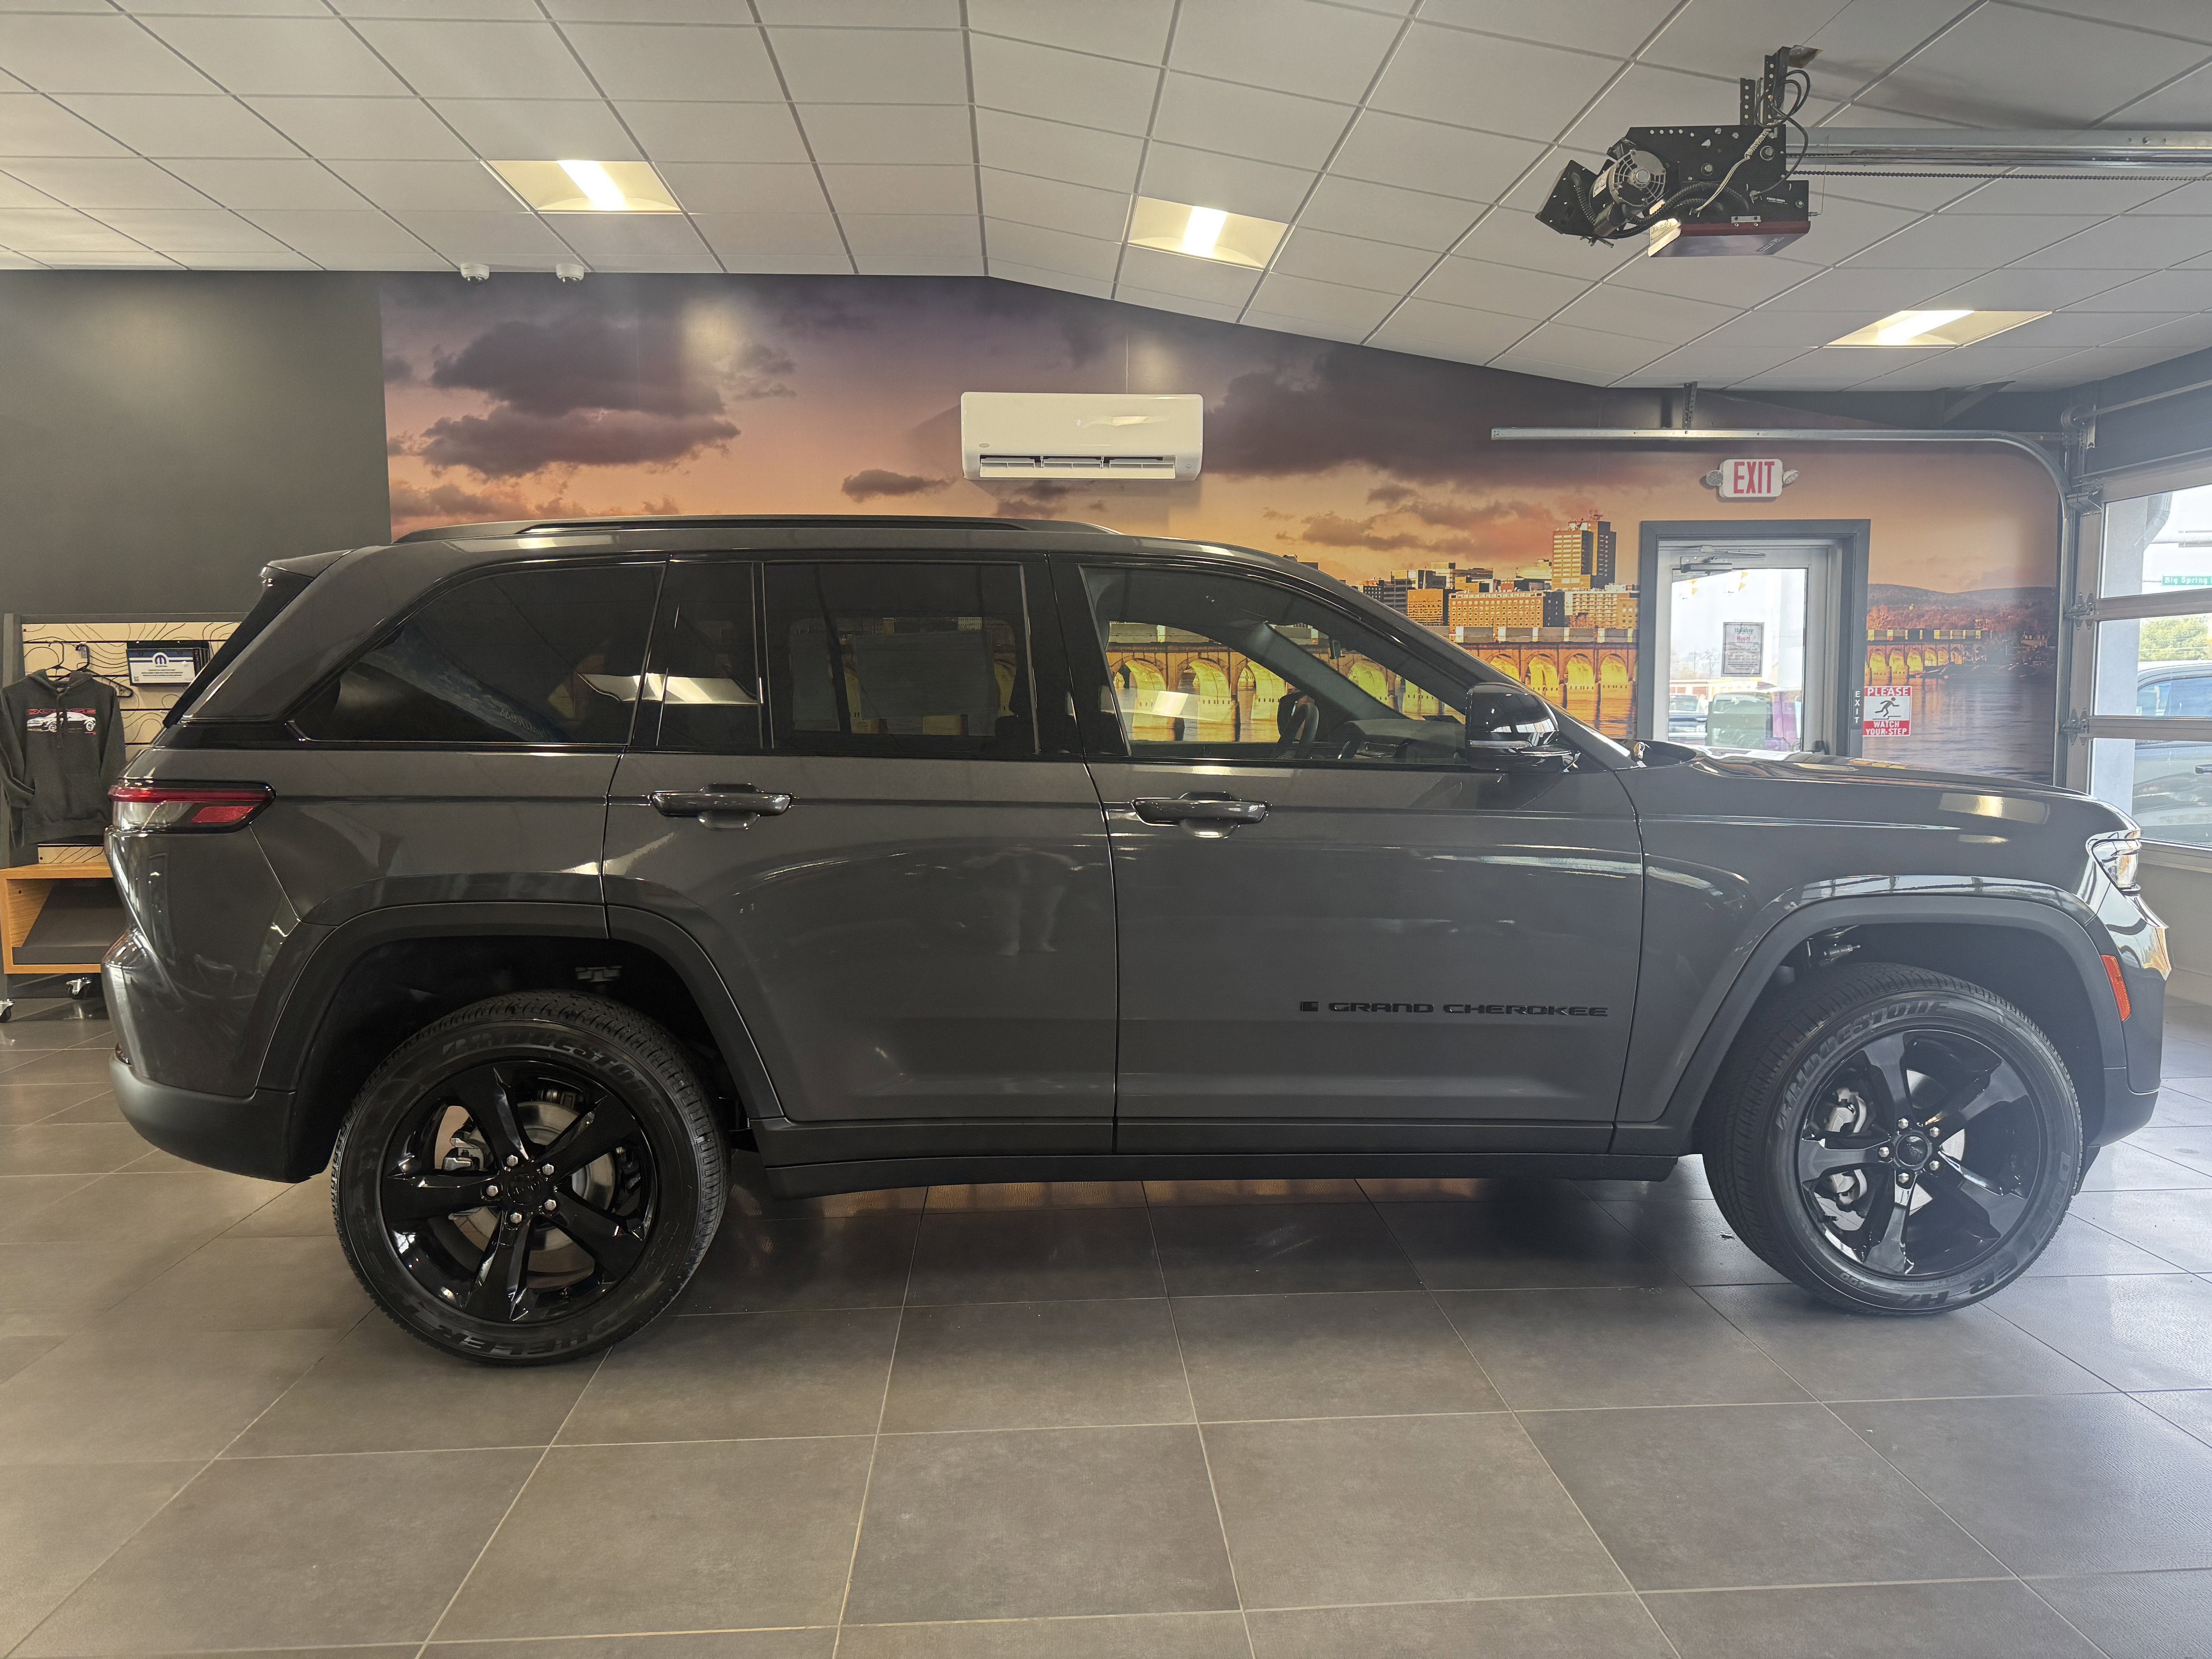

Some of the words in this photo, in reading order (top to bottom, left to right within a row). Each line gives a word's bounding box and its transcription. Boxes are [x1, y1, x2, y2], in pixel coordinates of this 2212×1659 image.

[1733, 461, 1775, 494] EXIT
[2164, 576, 2178, 585] Big
[2181, 576, 2208, 585] Spring
[1867, 687, 1908, 696] PLEASE
[1329, 1002, 1434, 1013] GRAND
[1443, 1004, 1608, 1017] CHEROKEE
